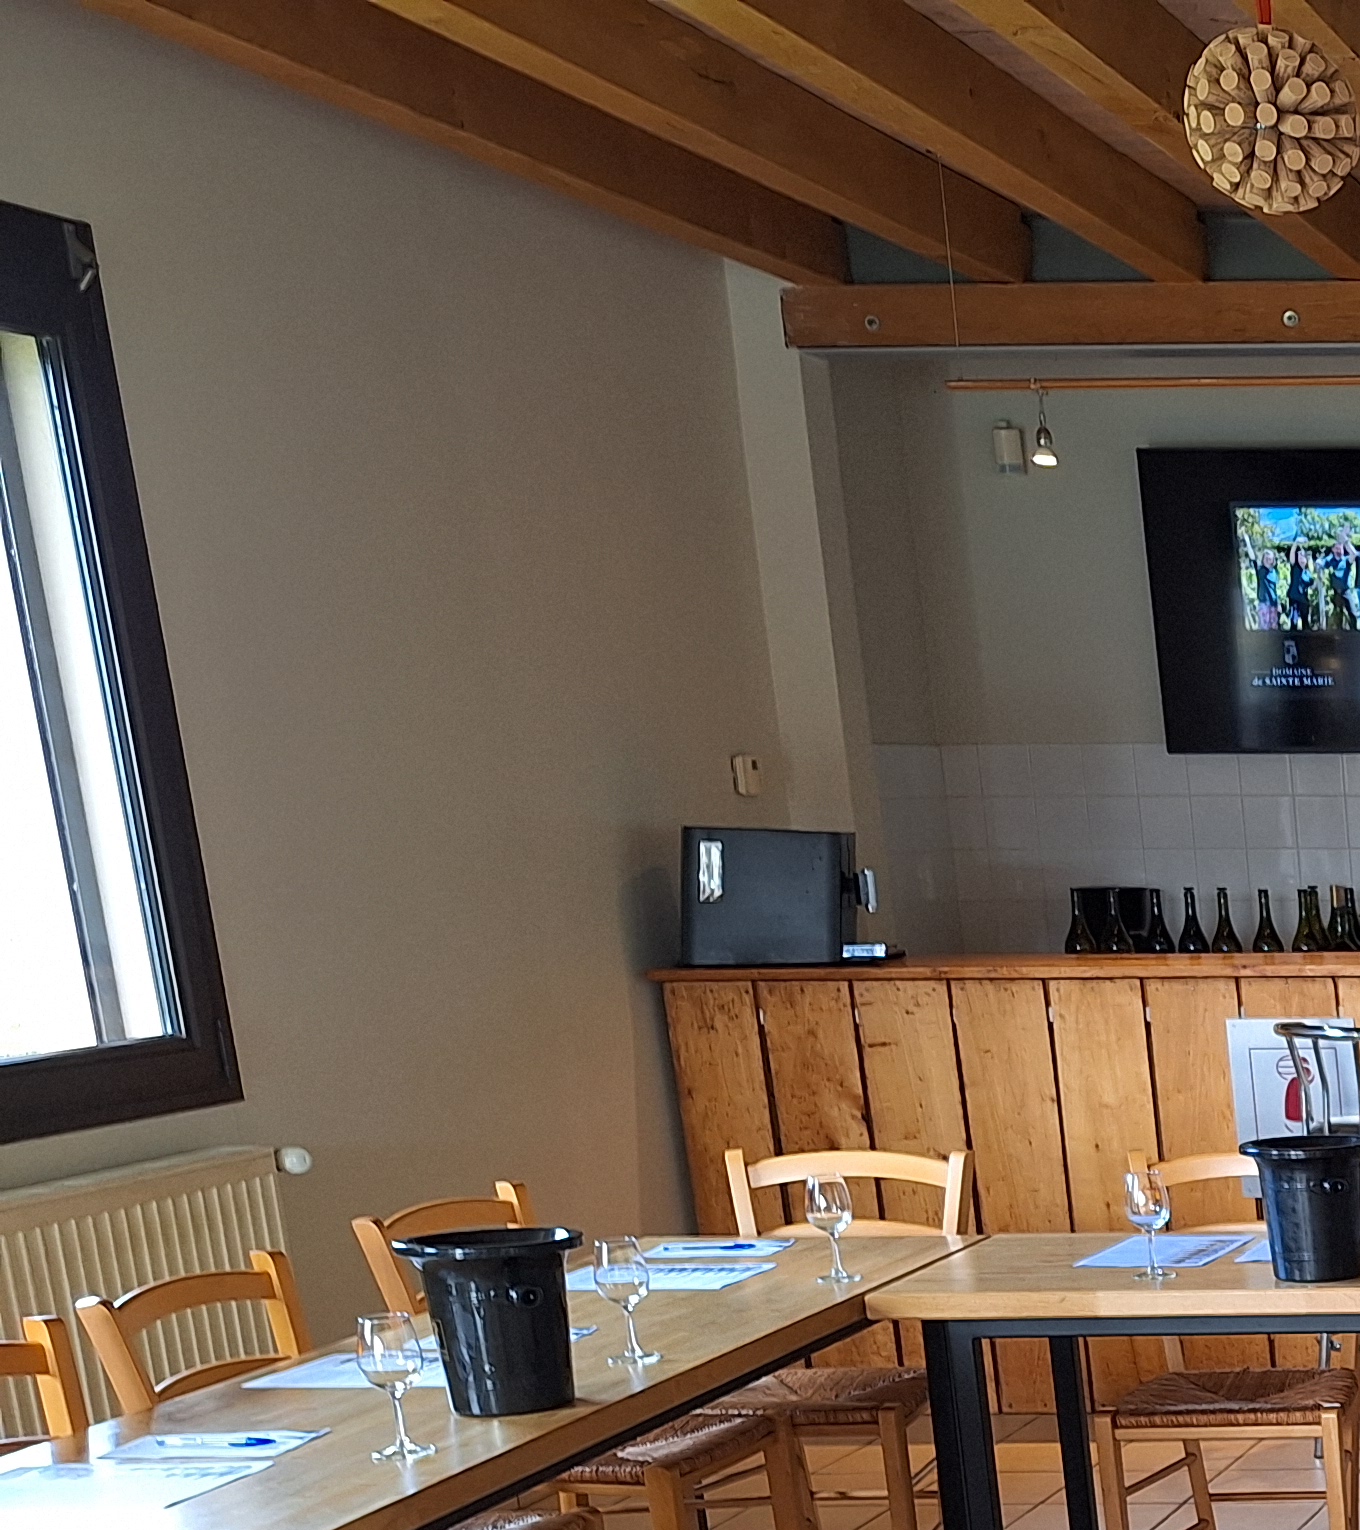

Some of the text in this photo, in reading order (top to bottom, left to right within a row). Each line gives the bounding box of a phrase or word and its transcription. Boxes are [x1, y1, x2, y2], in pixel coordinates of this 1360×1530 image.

[1272, 666, 1313, 676] DOMAINE
[1264, 676, 1301, 687] SAINTE
[1303, 675, 1335, 687] MARIE
